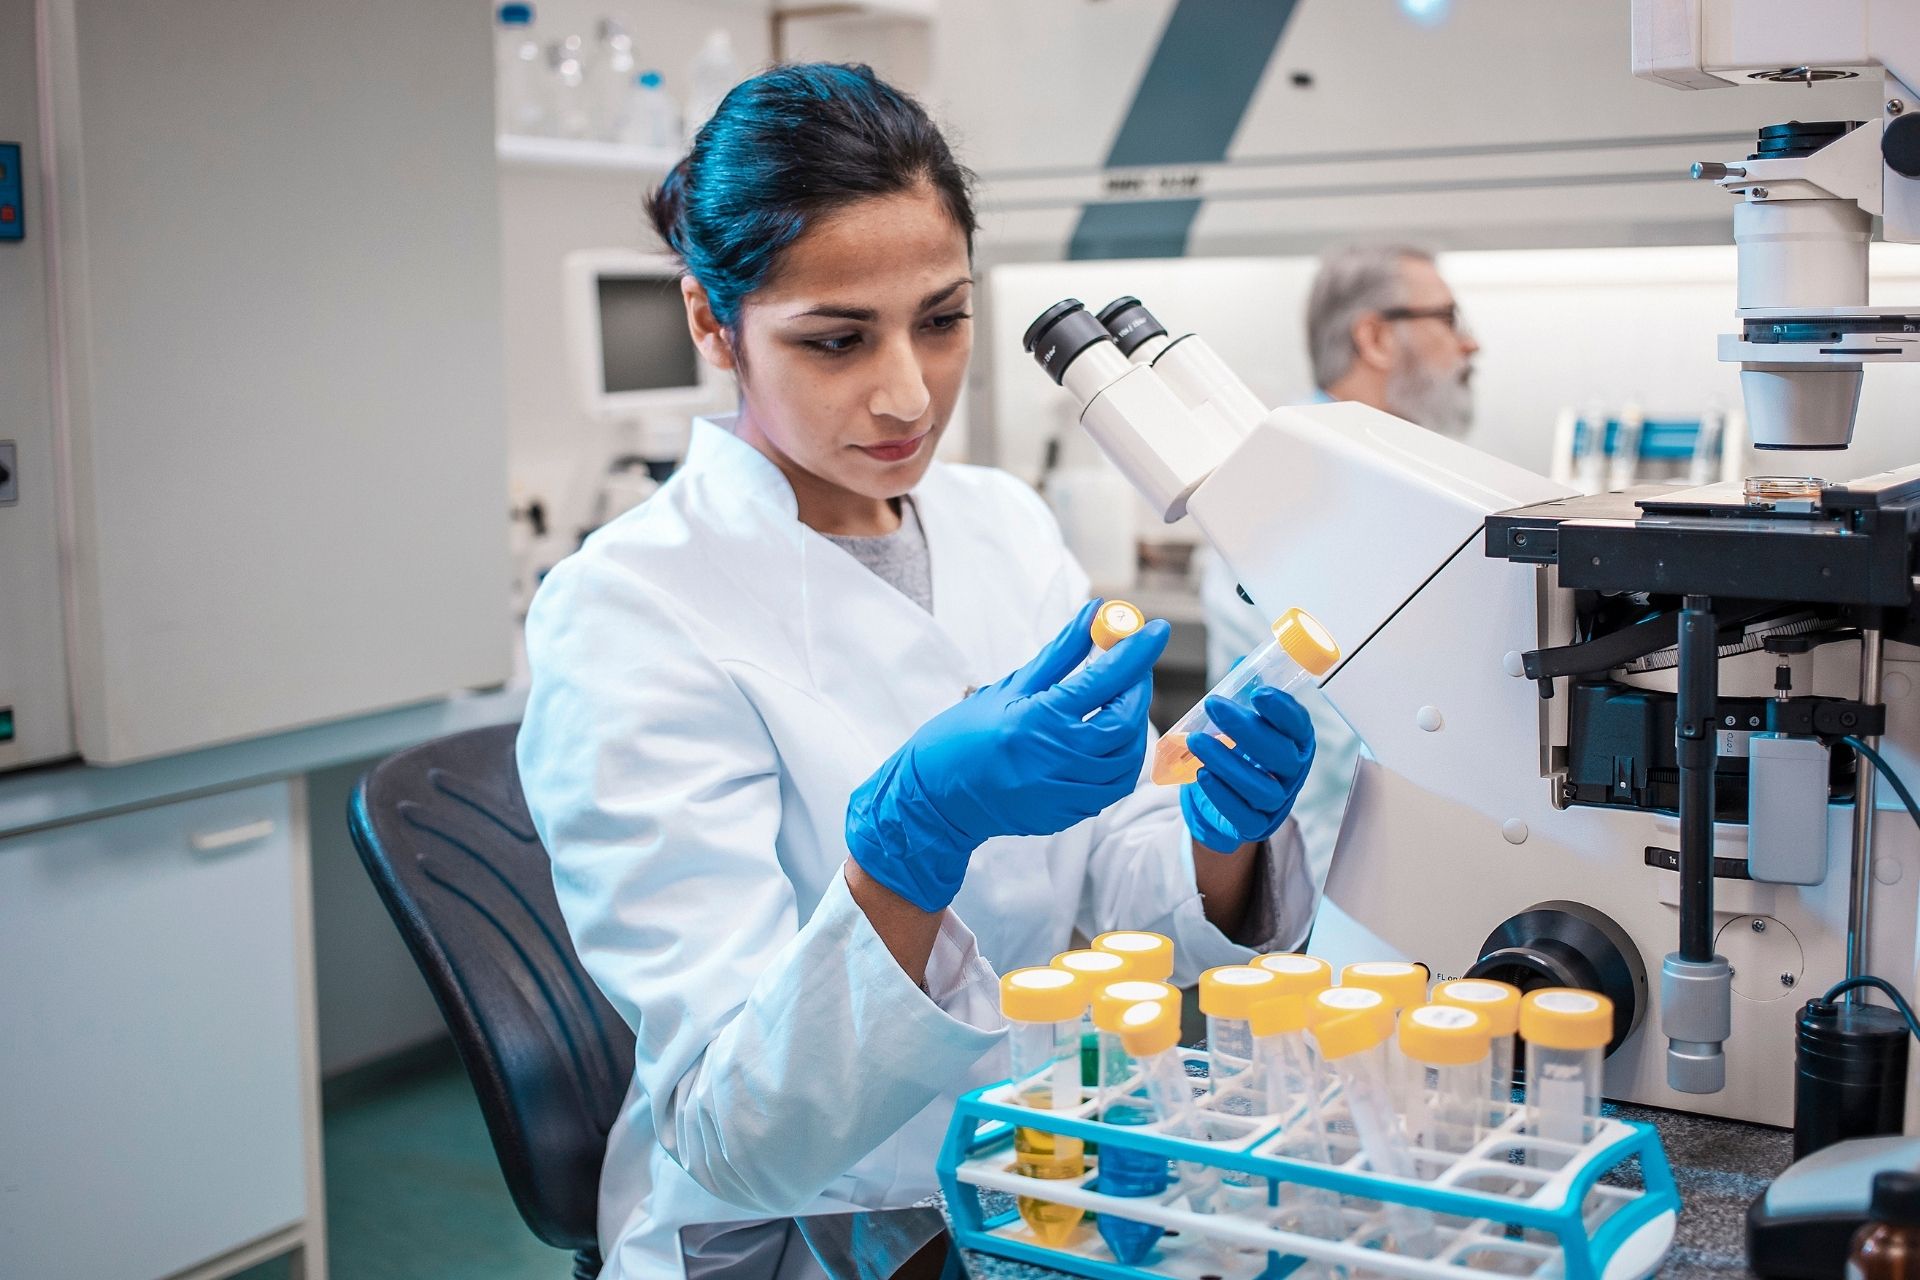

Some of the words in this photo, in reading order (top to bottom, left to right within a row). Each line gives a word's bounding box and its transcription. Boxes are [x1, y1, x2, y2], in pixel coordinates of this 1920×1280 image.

[1726, 732, 1734, 753] FOTO
[1669, 855, 1677, 865] 1x
[1437, 972, 1446, 981] FL
